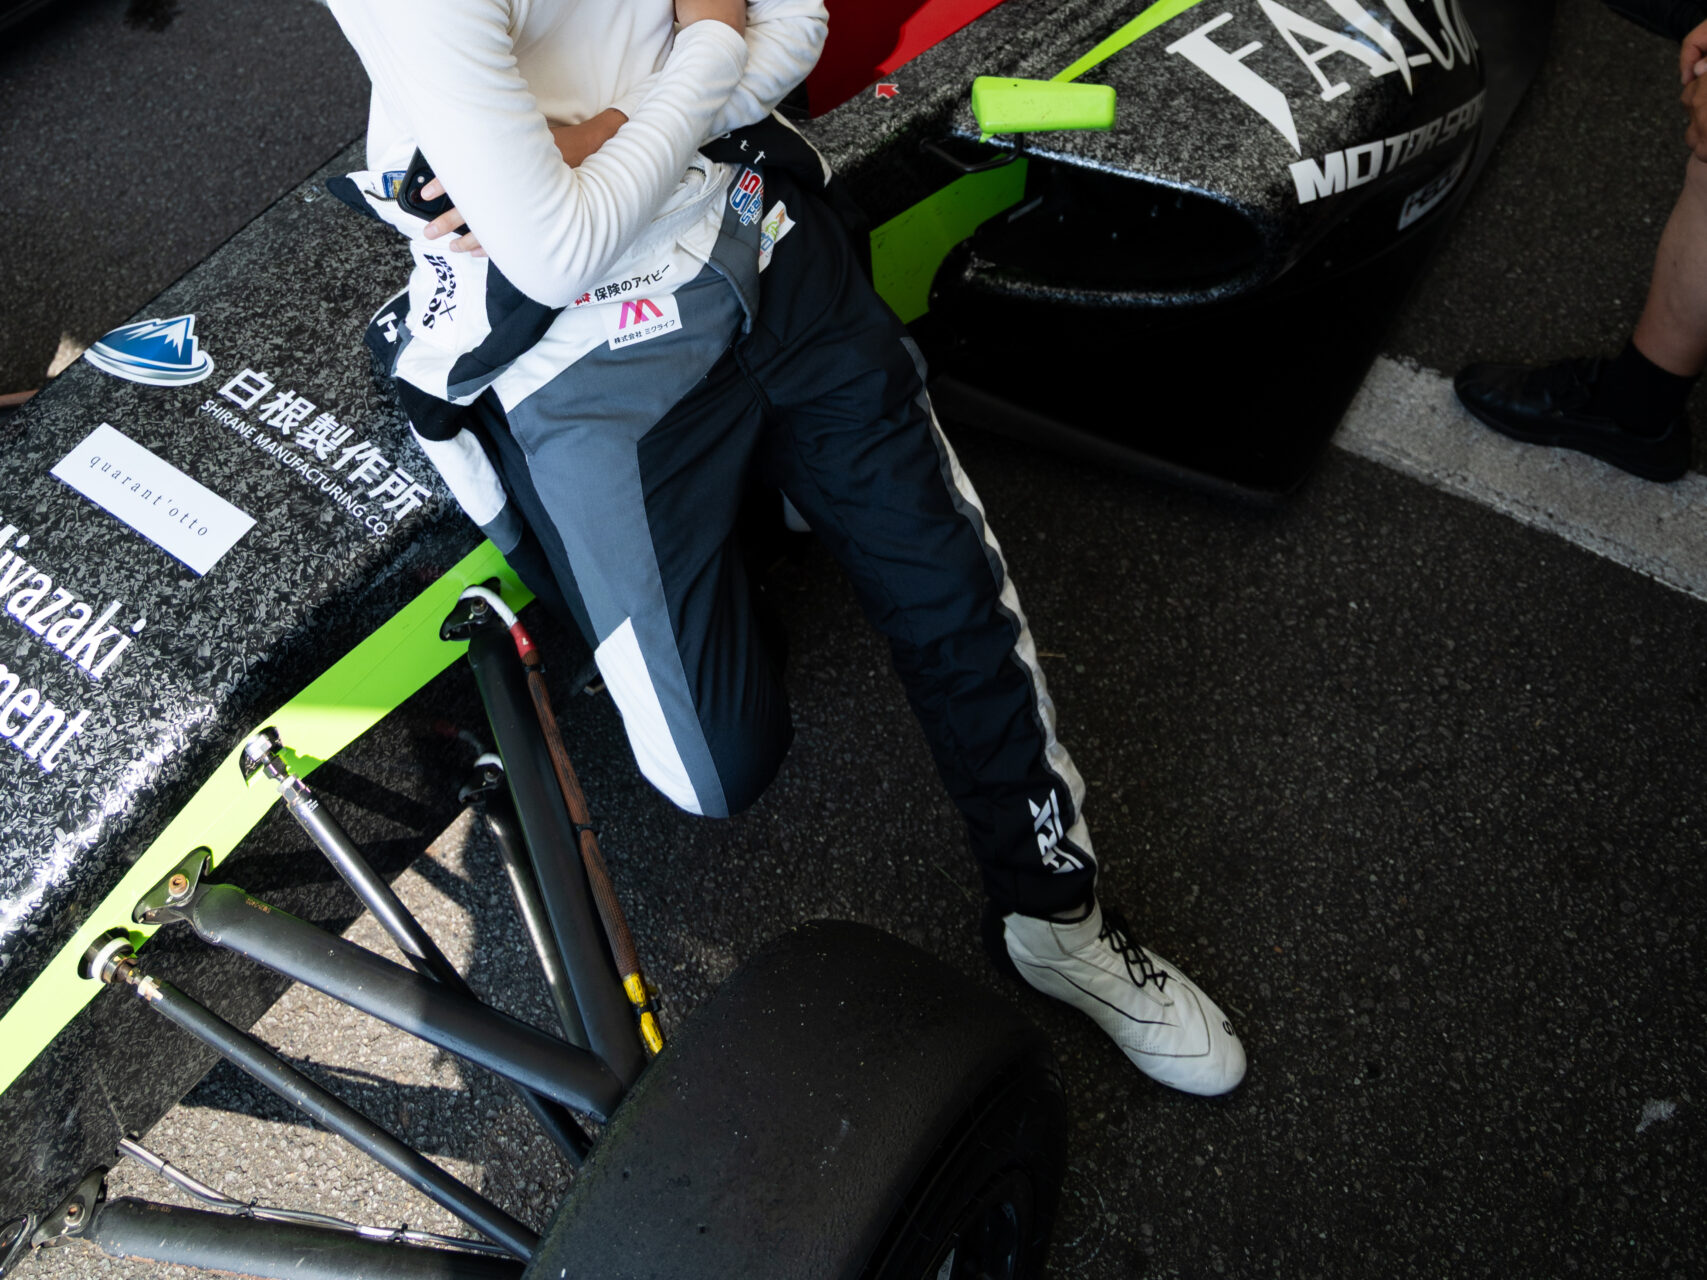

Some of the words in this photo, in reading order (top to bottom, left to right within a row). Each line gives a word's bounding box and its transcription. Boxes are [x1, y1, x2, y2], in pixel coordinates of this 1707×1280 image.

[423, 253, 448, 329] seven
[594, 264, 670, 301] 保険のアイビー
[200, 399, 257, 439] SHIRANE
[253, 427, 367, 517] MANUFACTURING
[365, 515, 388, 540] CO.
[217, 368, 432, 521] 白根製作所
[89, 455, 208, 536] quarant'otto
